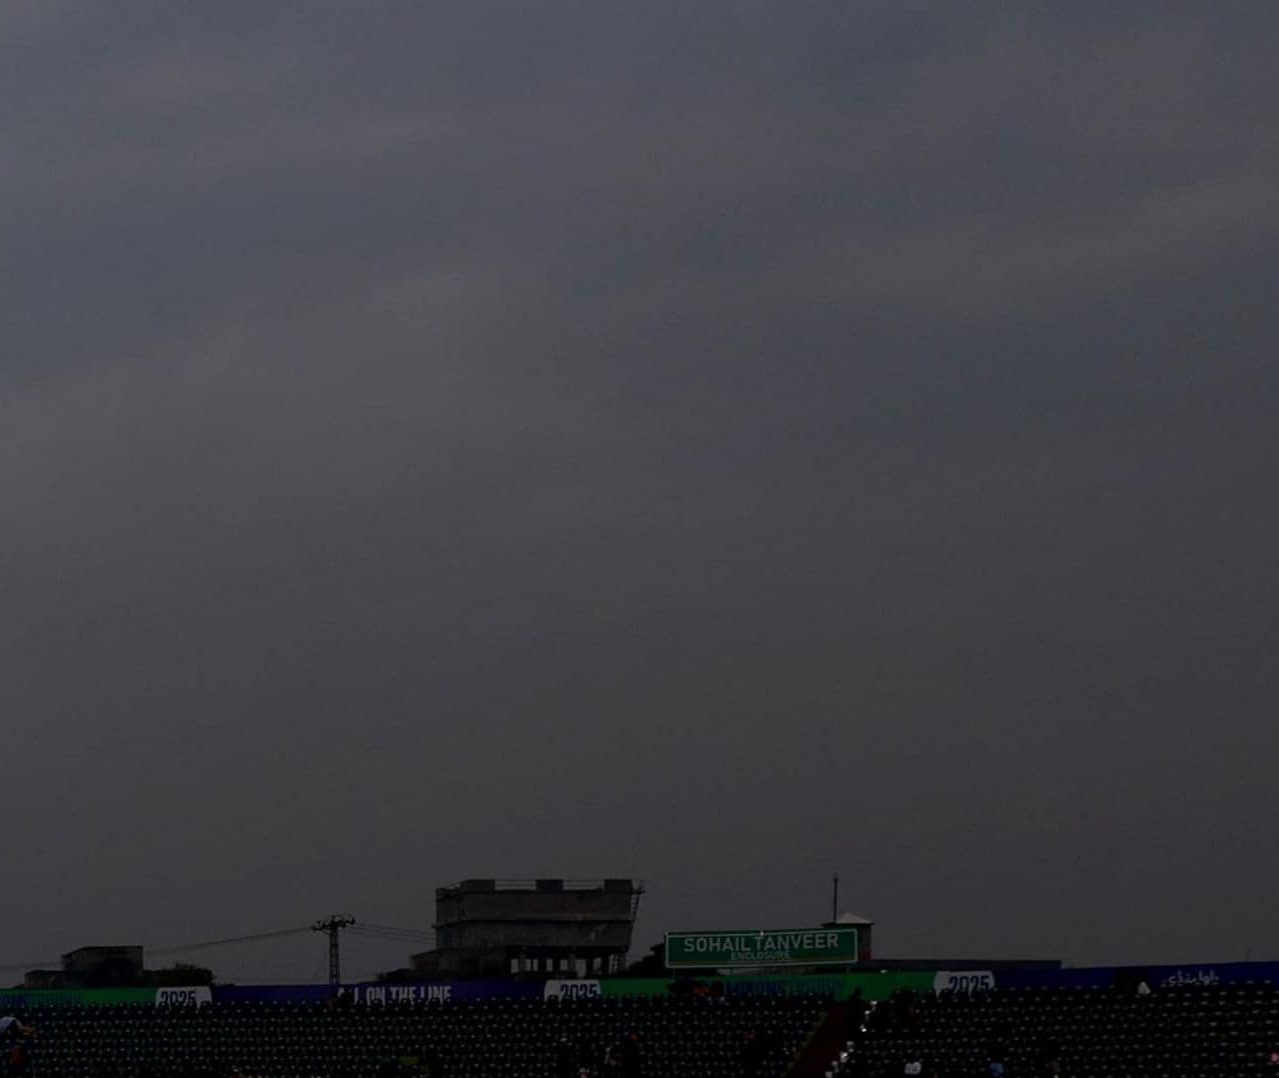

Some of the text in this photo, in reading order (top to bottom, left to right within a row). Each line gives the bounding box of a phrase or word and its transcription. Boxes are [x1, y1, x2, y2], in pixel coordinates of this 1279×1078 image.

[684, 934, 839, 953] SOHAIL TANVEER
[731, 950, 791, 961] ENCLOSURE
[949, 976, 989, 990] 2025
[560, 984, 597, 997] 2025
[161, 991, 195, 1005] 2025
